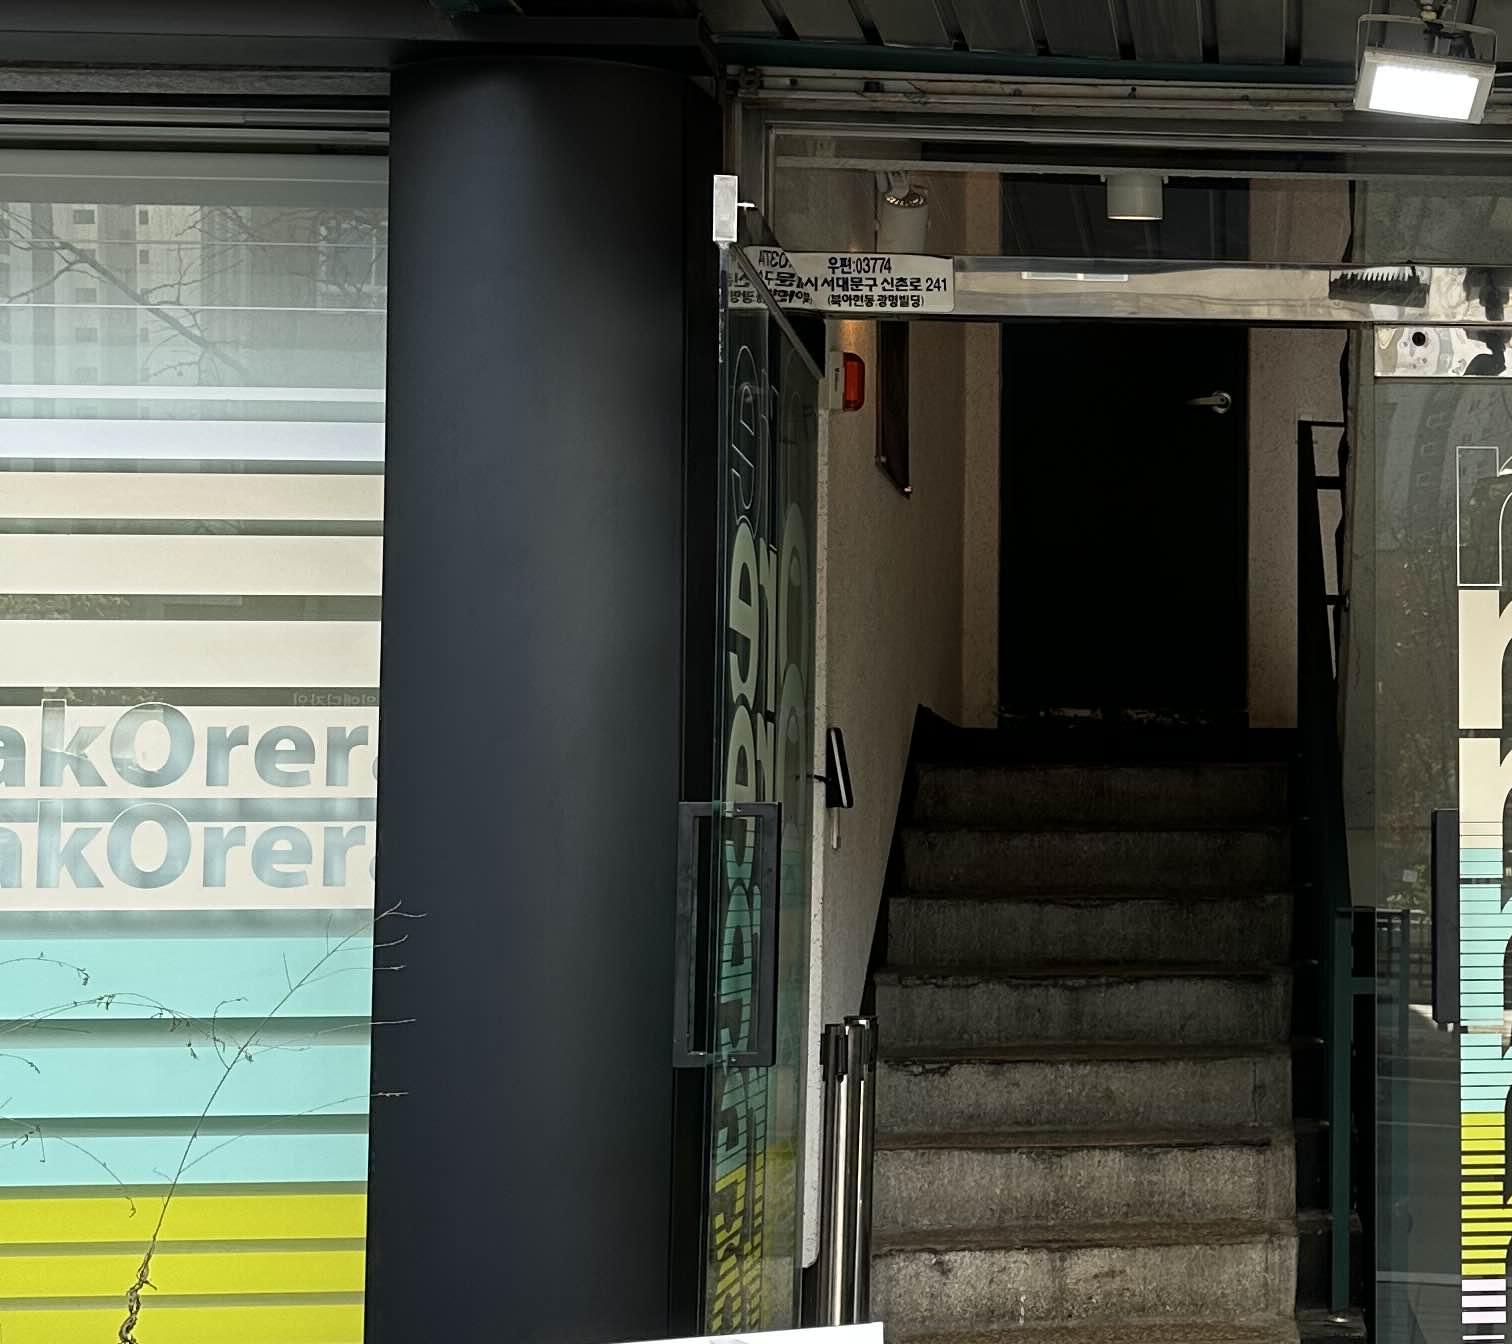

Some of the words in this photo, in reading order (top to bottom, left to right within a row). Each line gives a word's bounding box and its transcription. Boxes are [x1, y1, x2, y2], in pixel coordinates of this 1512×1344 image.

[821, 277, 878, 292] 서대문구
[881, 277, 922, 292] 신촌로
[925, 277, 947, 291] 241
